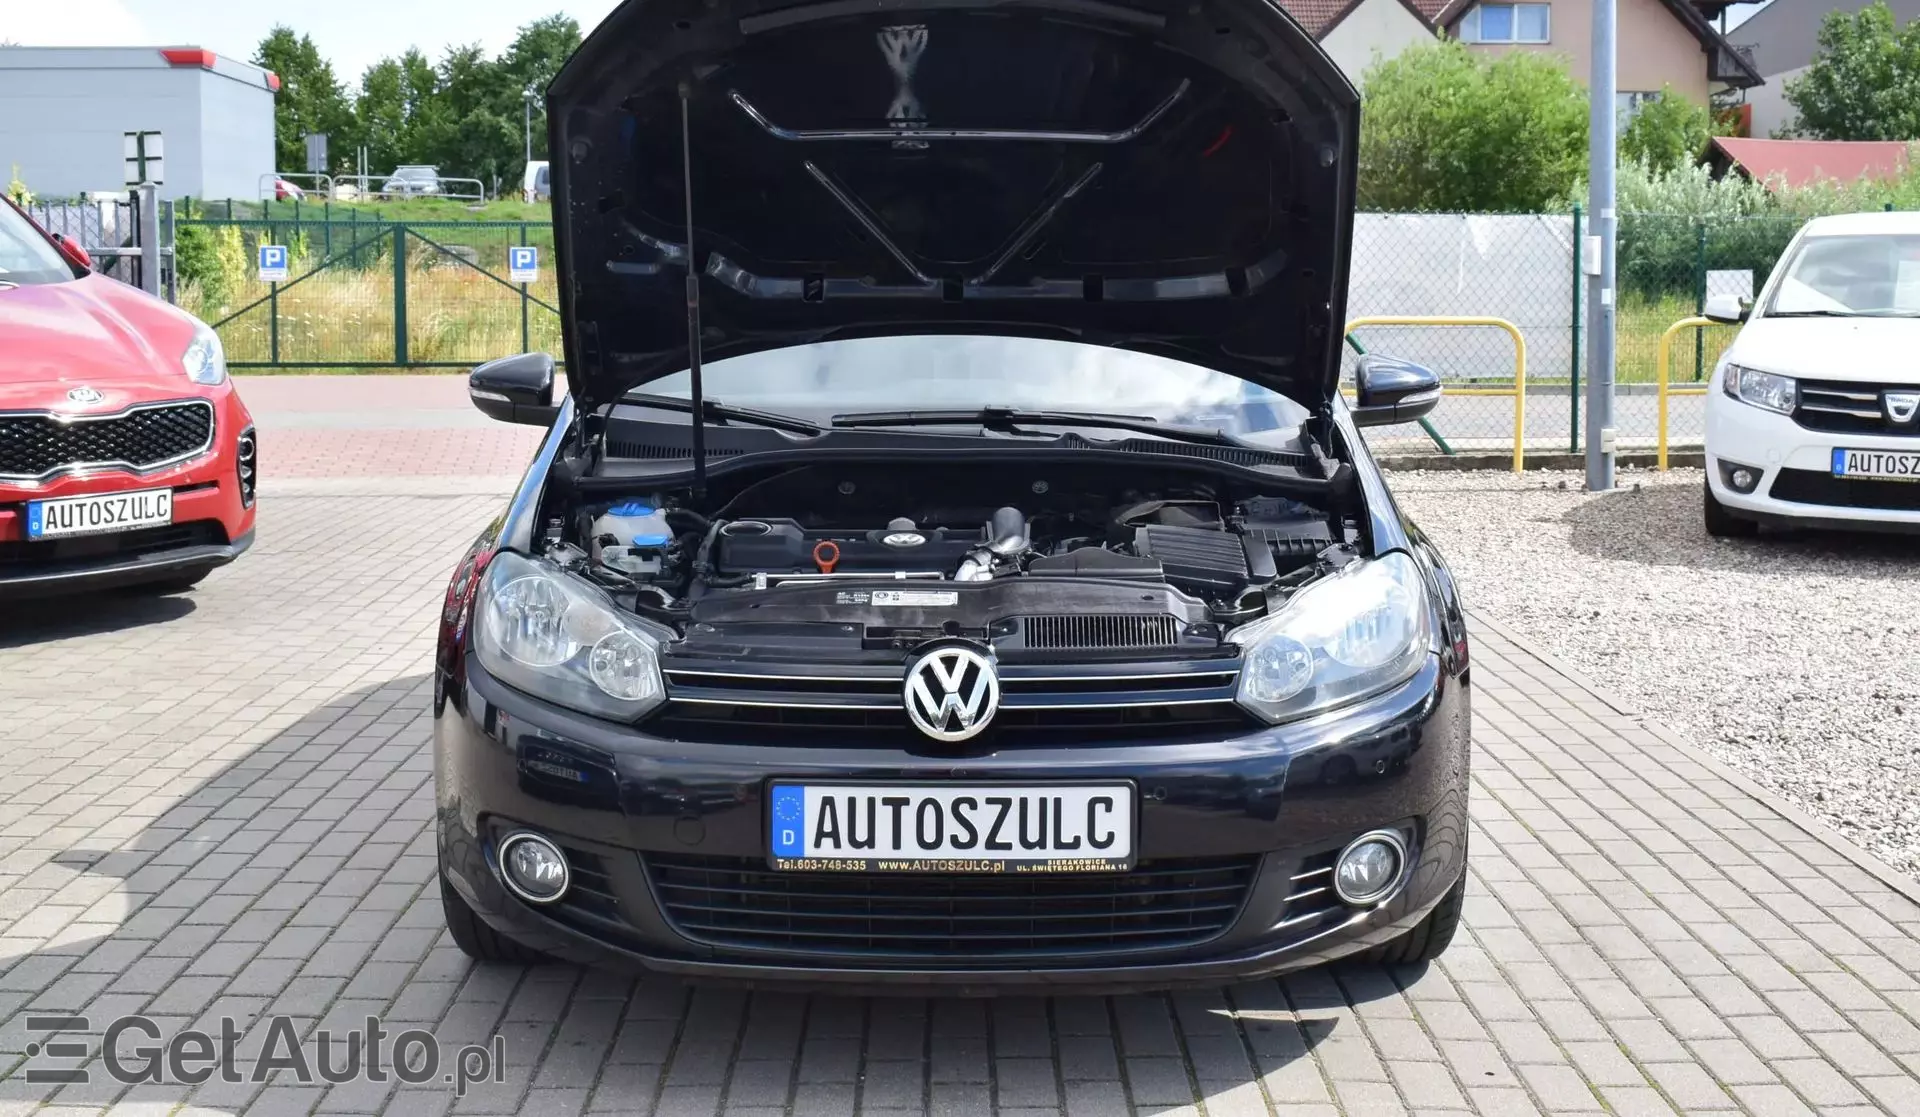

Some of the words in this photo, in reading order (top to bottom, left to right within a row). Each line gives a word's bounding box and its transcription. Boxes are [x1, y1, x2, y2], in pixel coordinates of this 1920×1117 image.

[265, 249, 281, 267] P
[516, 250, 532, 268] P
[45, 494, 168, 530] AUTOSZULC
[813, 795, 1116, 851] AUTOSZULC
[782, 829, 795, 846] D
[878, 859, 1005, 873] www.AUTOSZULC.pl
